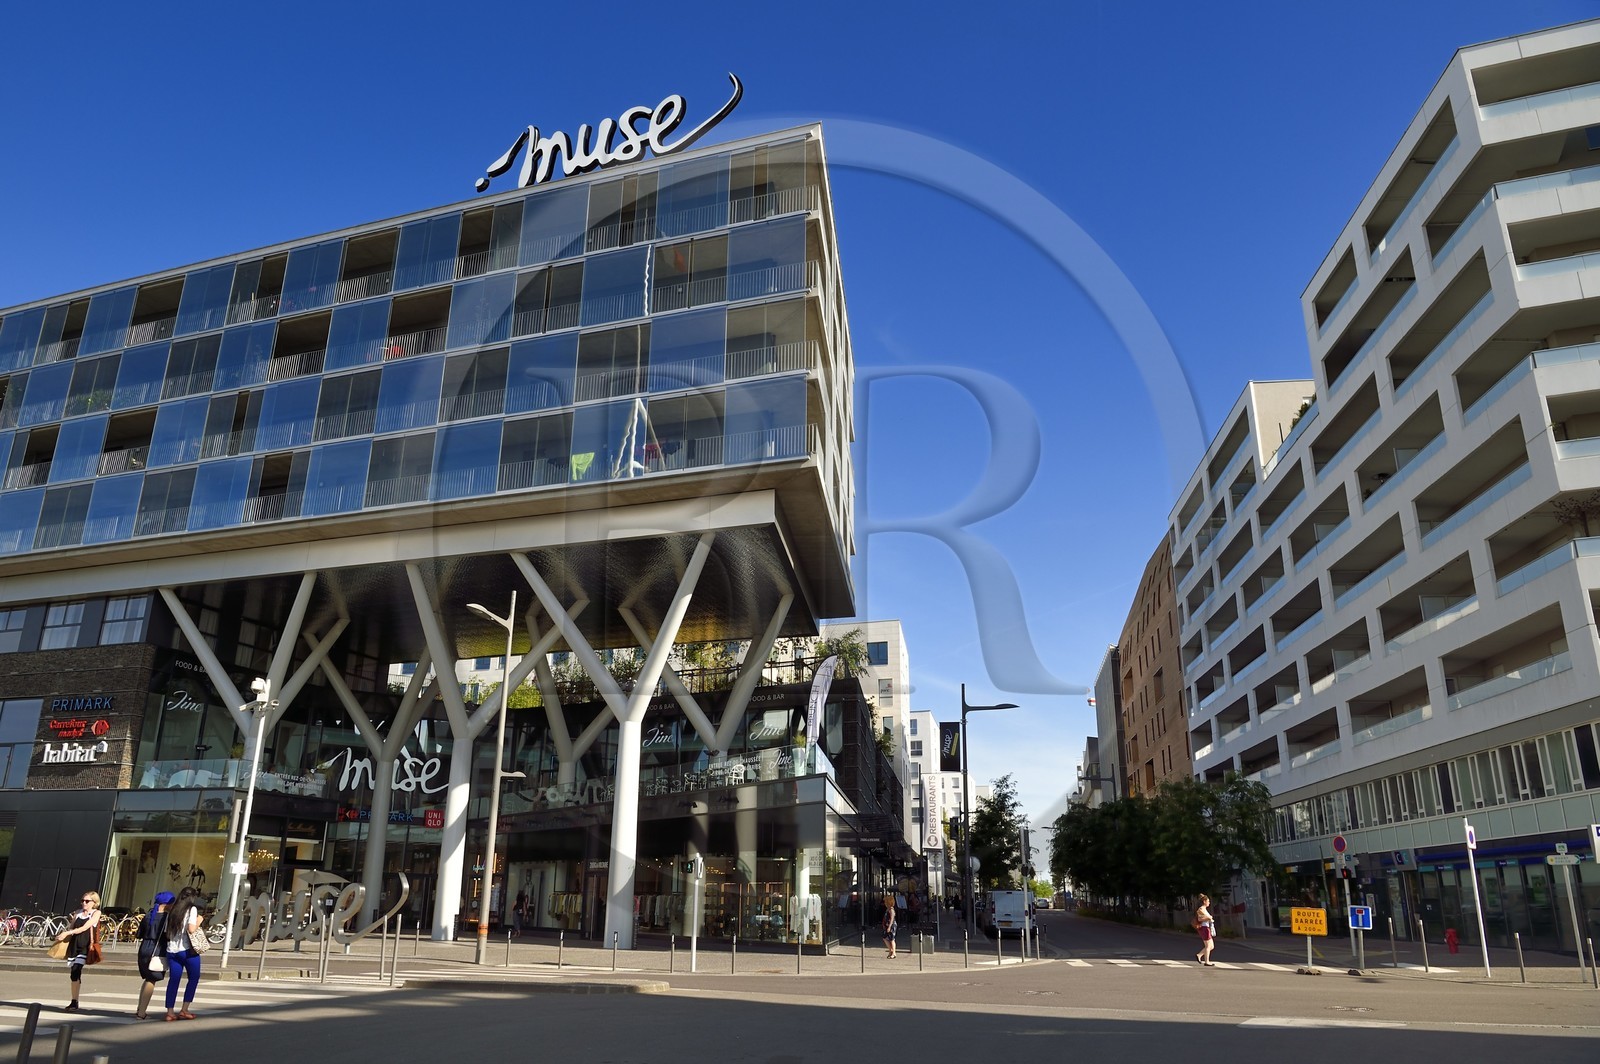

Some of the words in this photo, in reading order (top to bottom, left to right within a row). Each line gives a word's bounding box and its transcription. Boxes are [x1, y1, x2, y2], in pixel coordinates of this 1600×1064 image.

[475, 72, 743, 192] muse
[175, 660, 193, 670] FOOD
[52, 696, 113, 711] PRIMARK
[752, 694, 766, 702] OOD
[41, 742, 97, 763] habitat
[928, 775, 938, 835] RESTAURANTS
[427, 819, 442, 827] QLO
